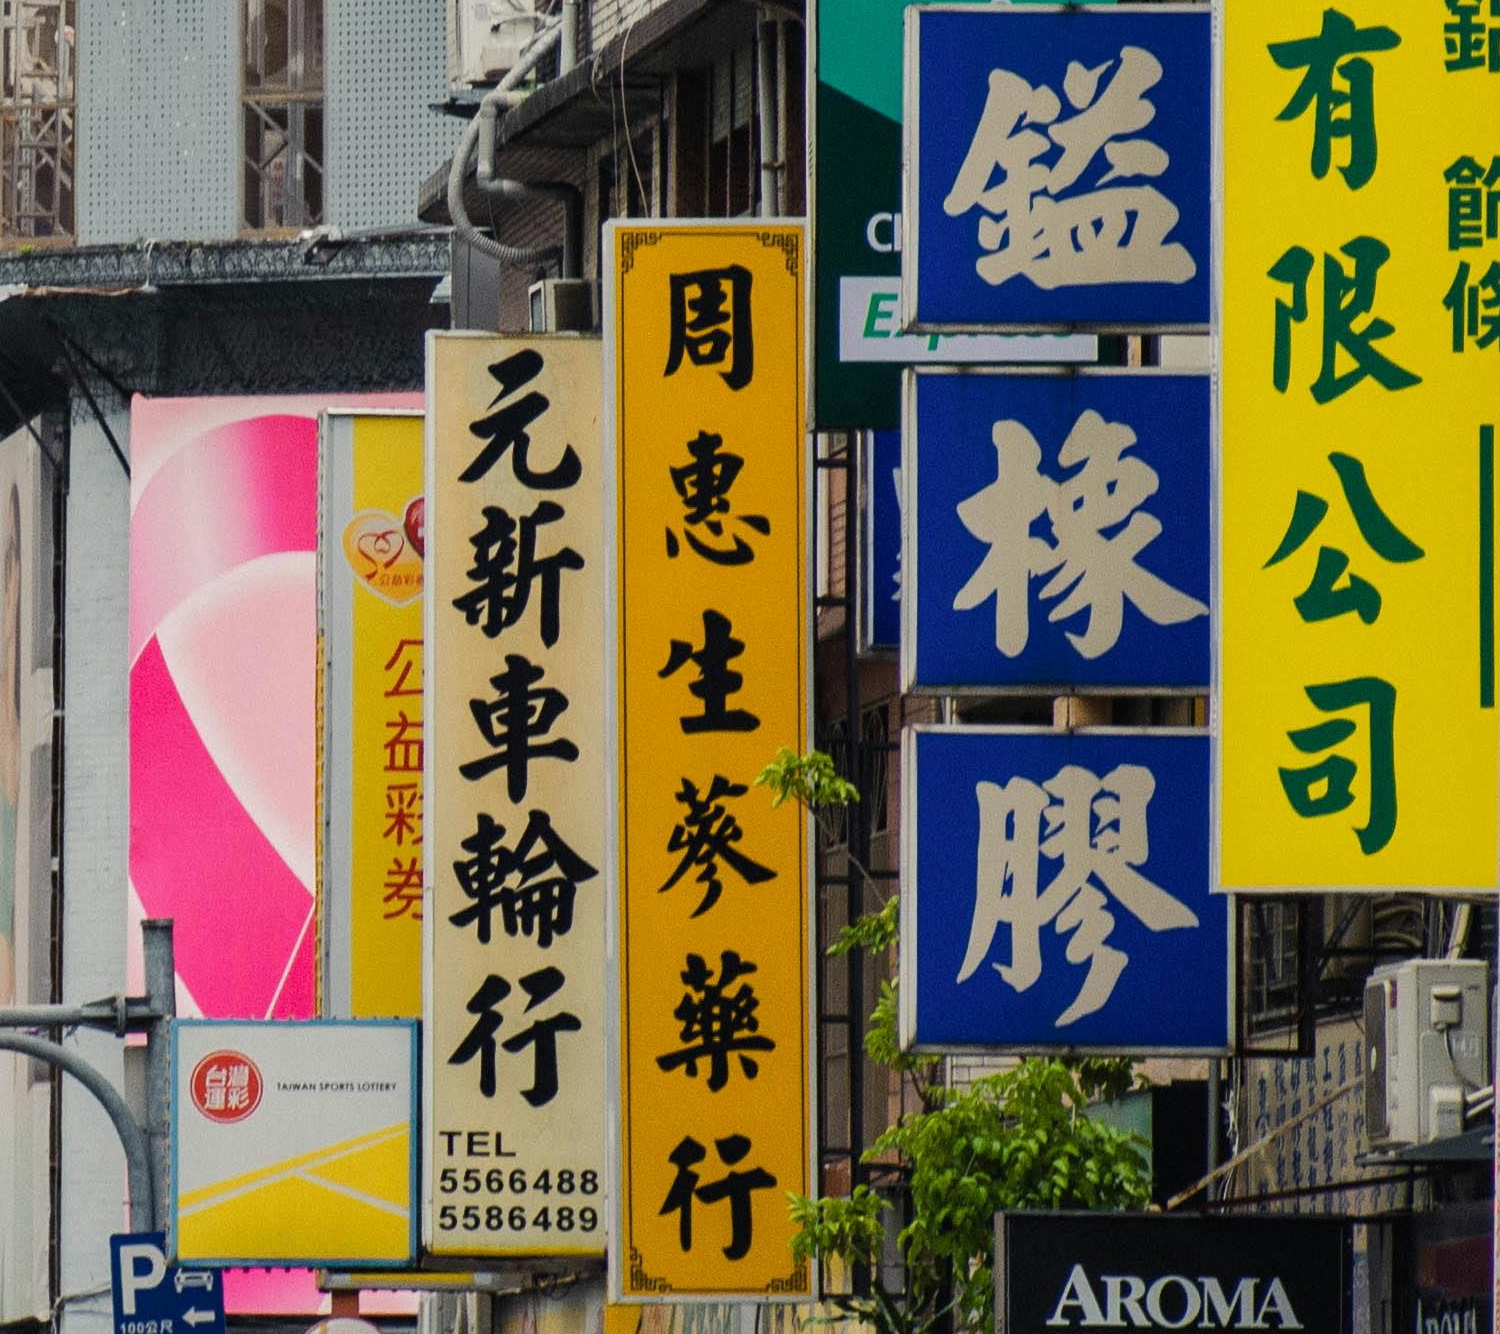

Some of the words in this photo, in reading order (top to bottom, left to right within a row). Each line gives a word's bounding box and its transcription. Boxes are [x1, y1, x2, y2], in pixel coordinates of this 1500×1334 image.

[449, 348, 600, 1108] 元新車輪行
[656, 263, 779, 1261] 周惠生蔘藥行
[276, 1079, 316, 1094] TAIWAN
[319, 1079, 356, 1094] SPORTS
[358, 1078, 397, 1093] LOTTERY
[438, 1130, 518, 1158] TEL
[438, 1167, 600, 1196] 5566488
[438, 1205, 599, 1233] 5586489
[119, 1244, 166, 1316] P
[1046, 1263, 1305, 1330] AROMA
